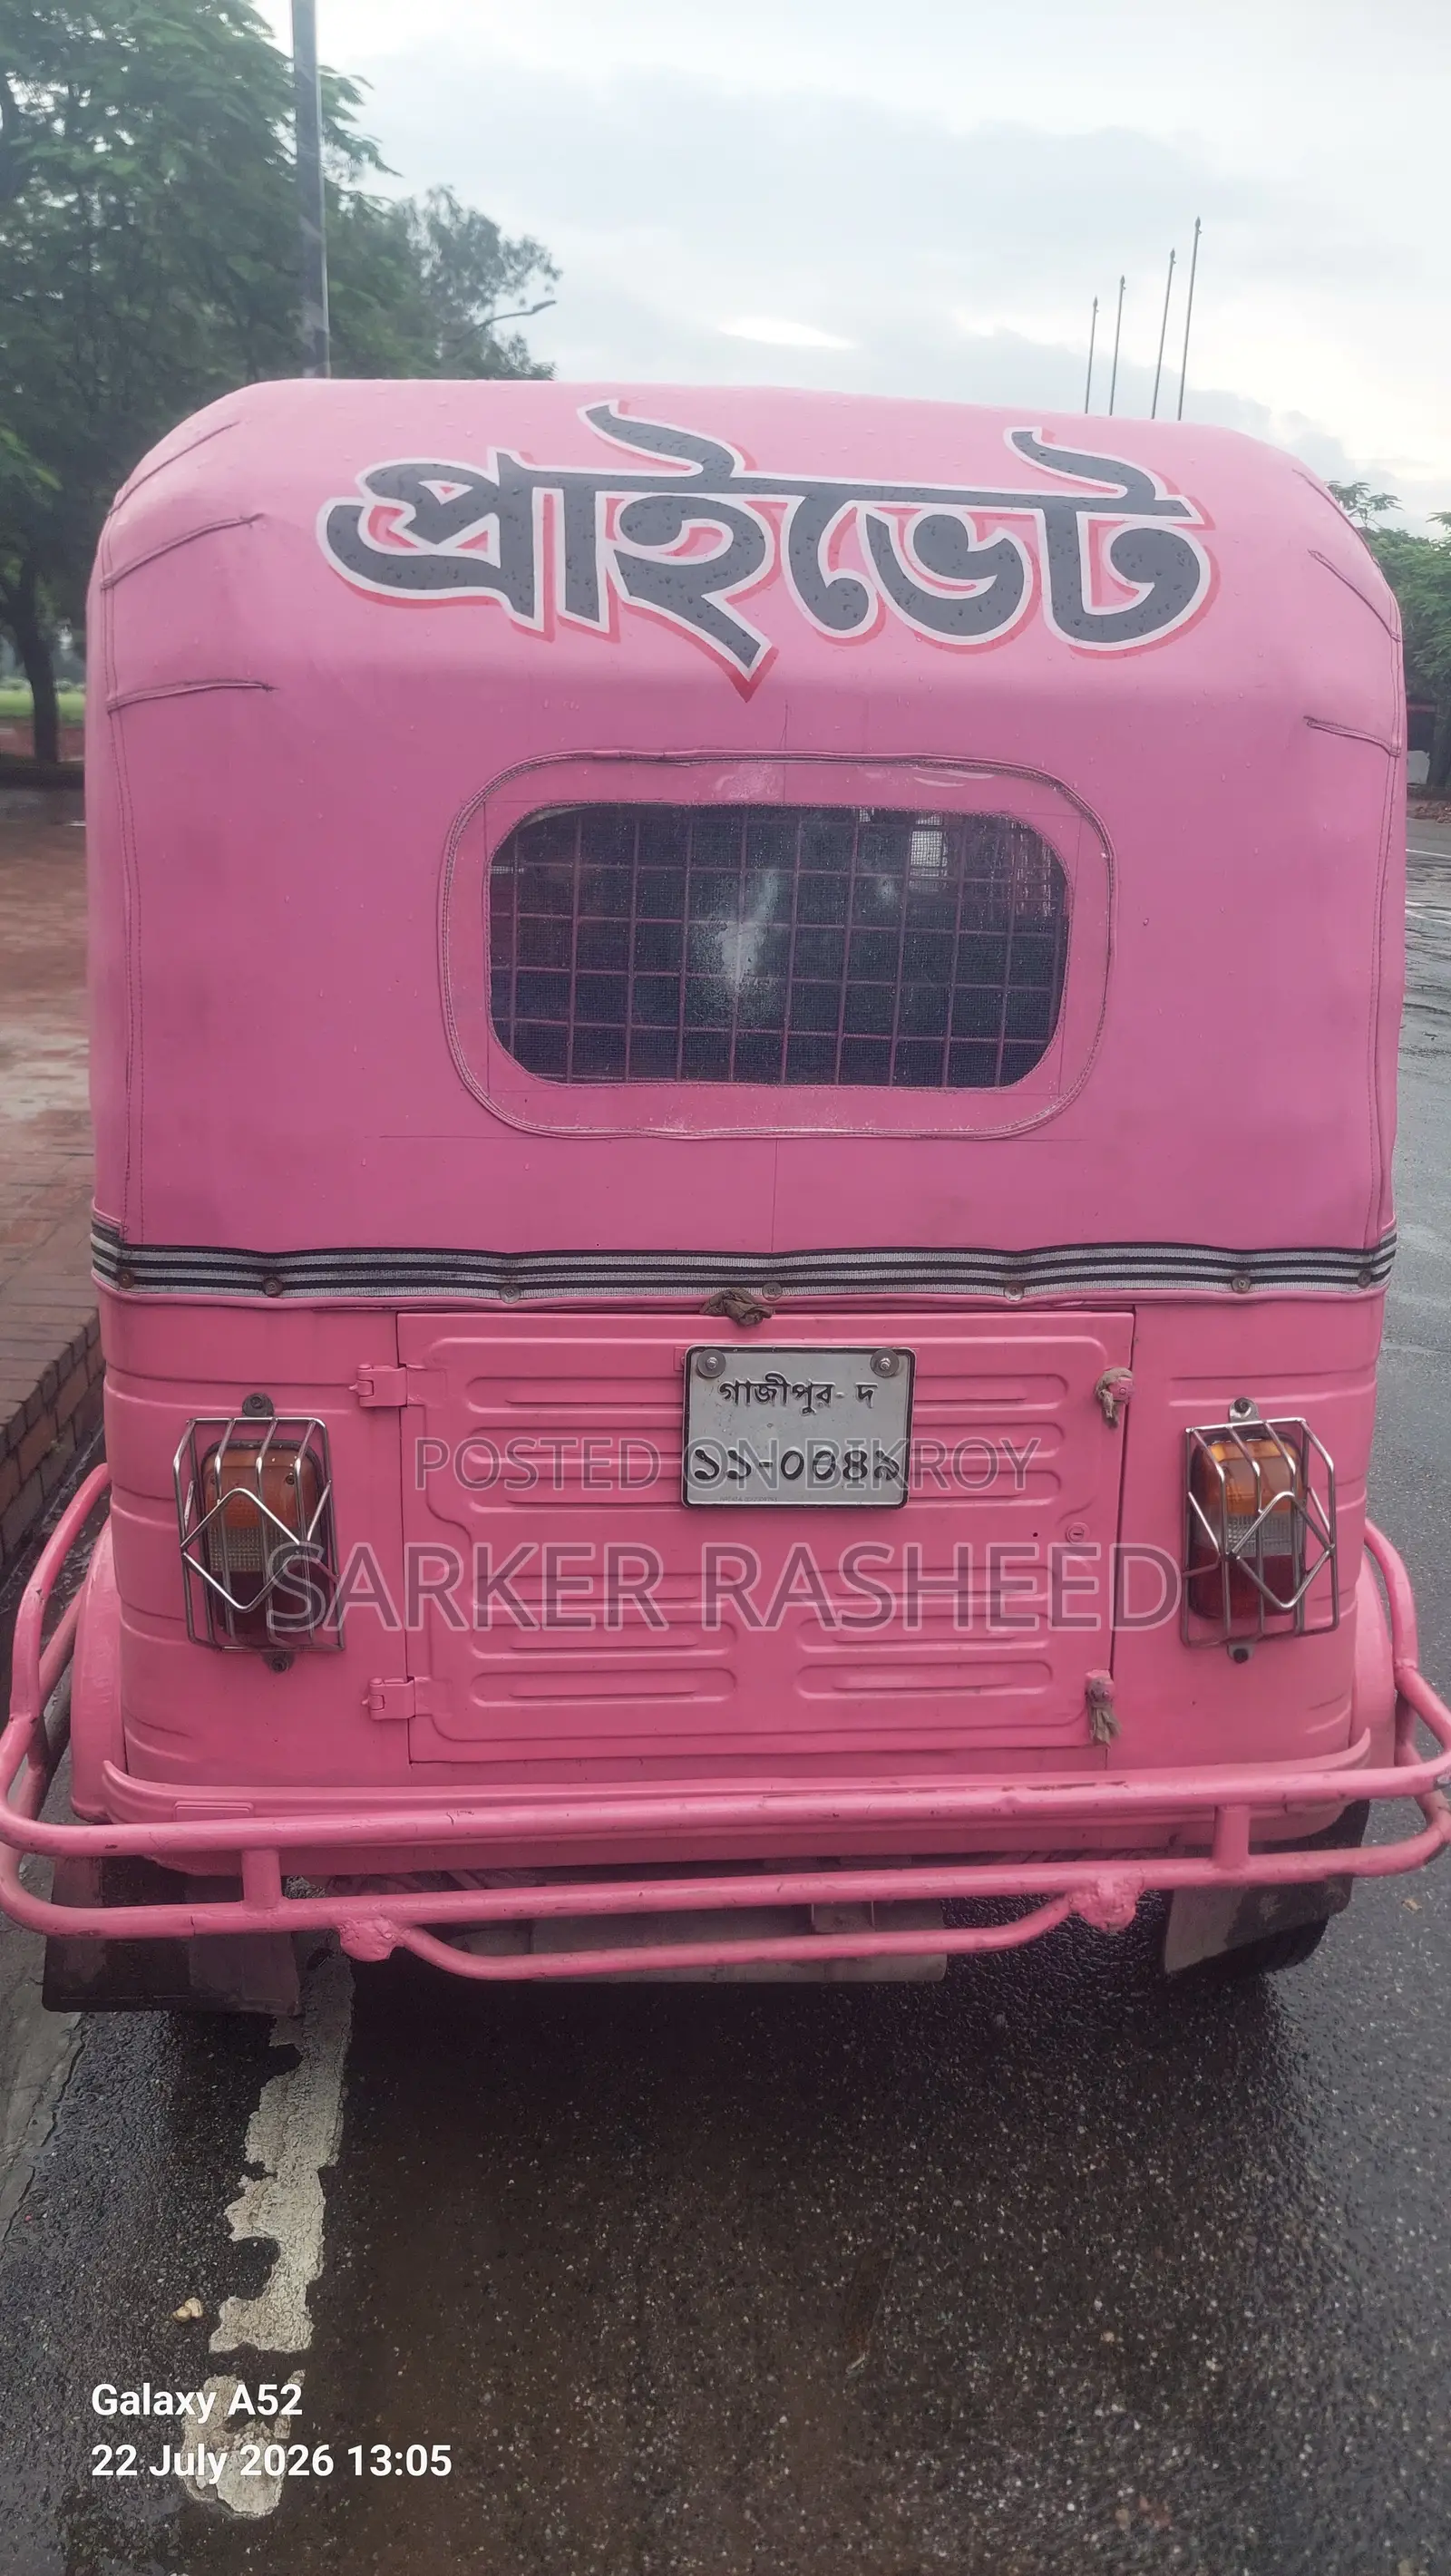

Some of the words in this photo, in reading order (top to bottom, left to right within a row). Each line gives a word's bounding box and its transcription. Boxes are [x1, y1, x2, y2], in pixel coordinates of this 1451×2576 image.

[318, 400, 1213, 691] প্রাইভেট
[855, 1382, 878, 1408] দ
[694, 1448, 900, 1480] ১১-০০৪৯
